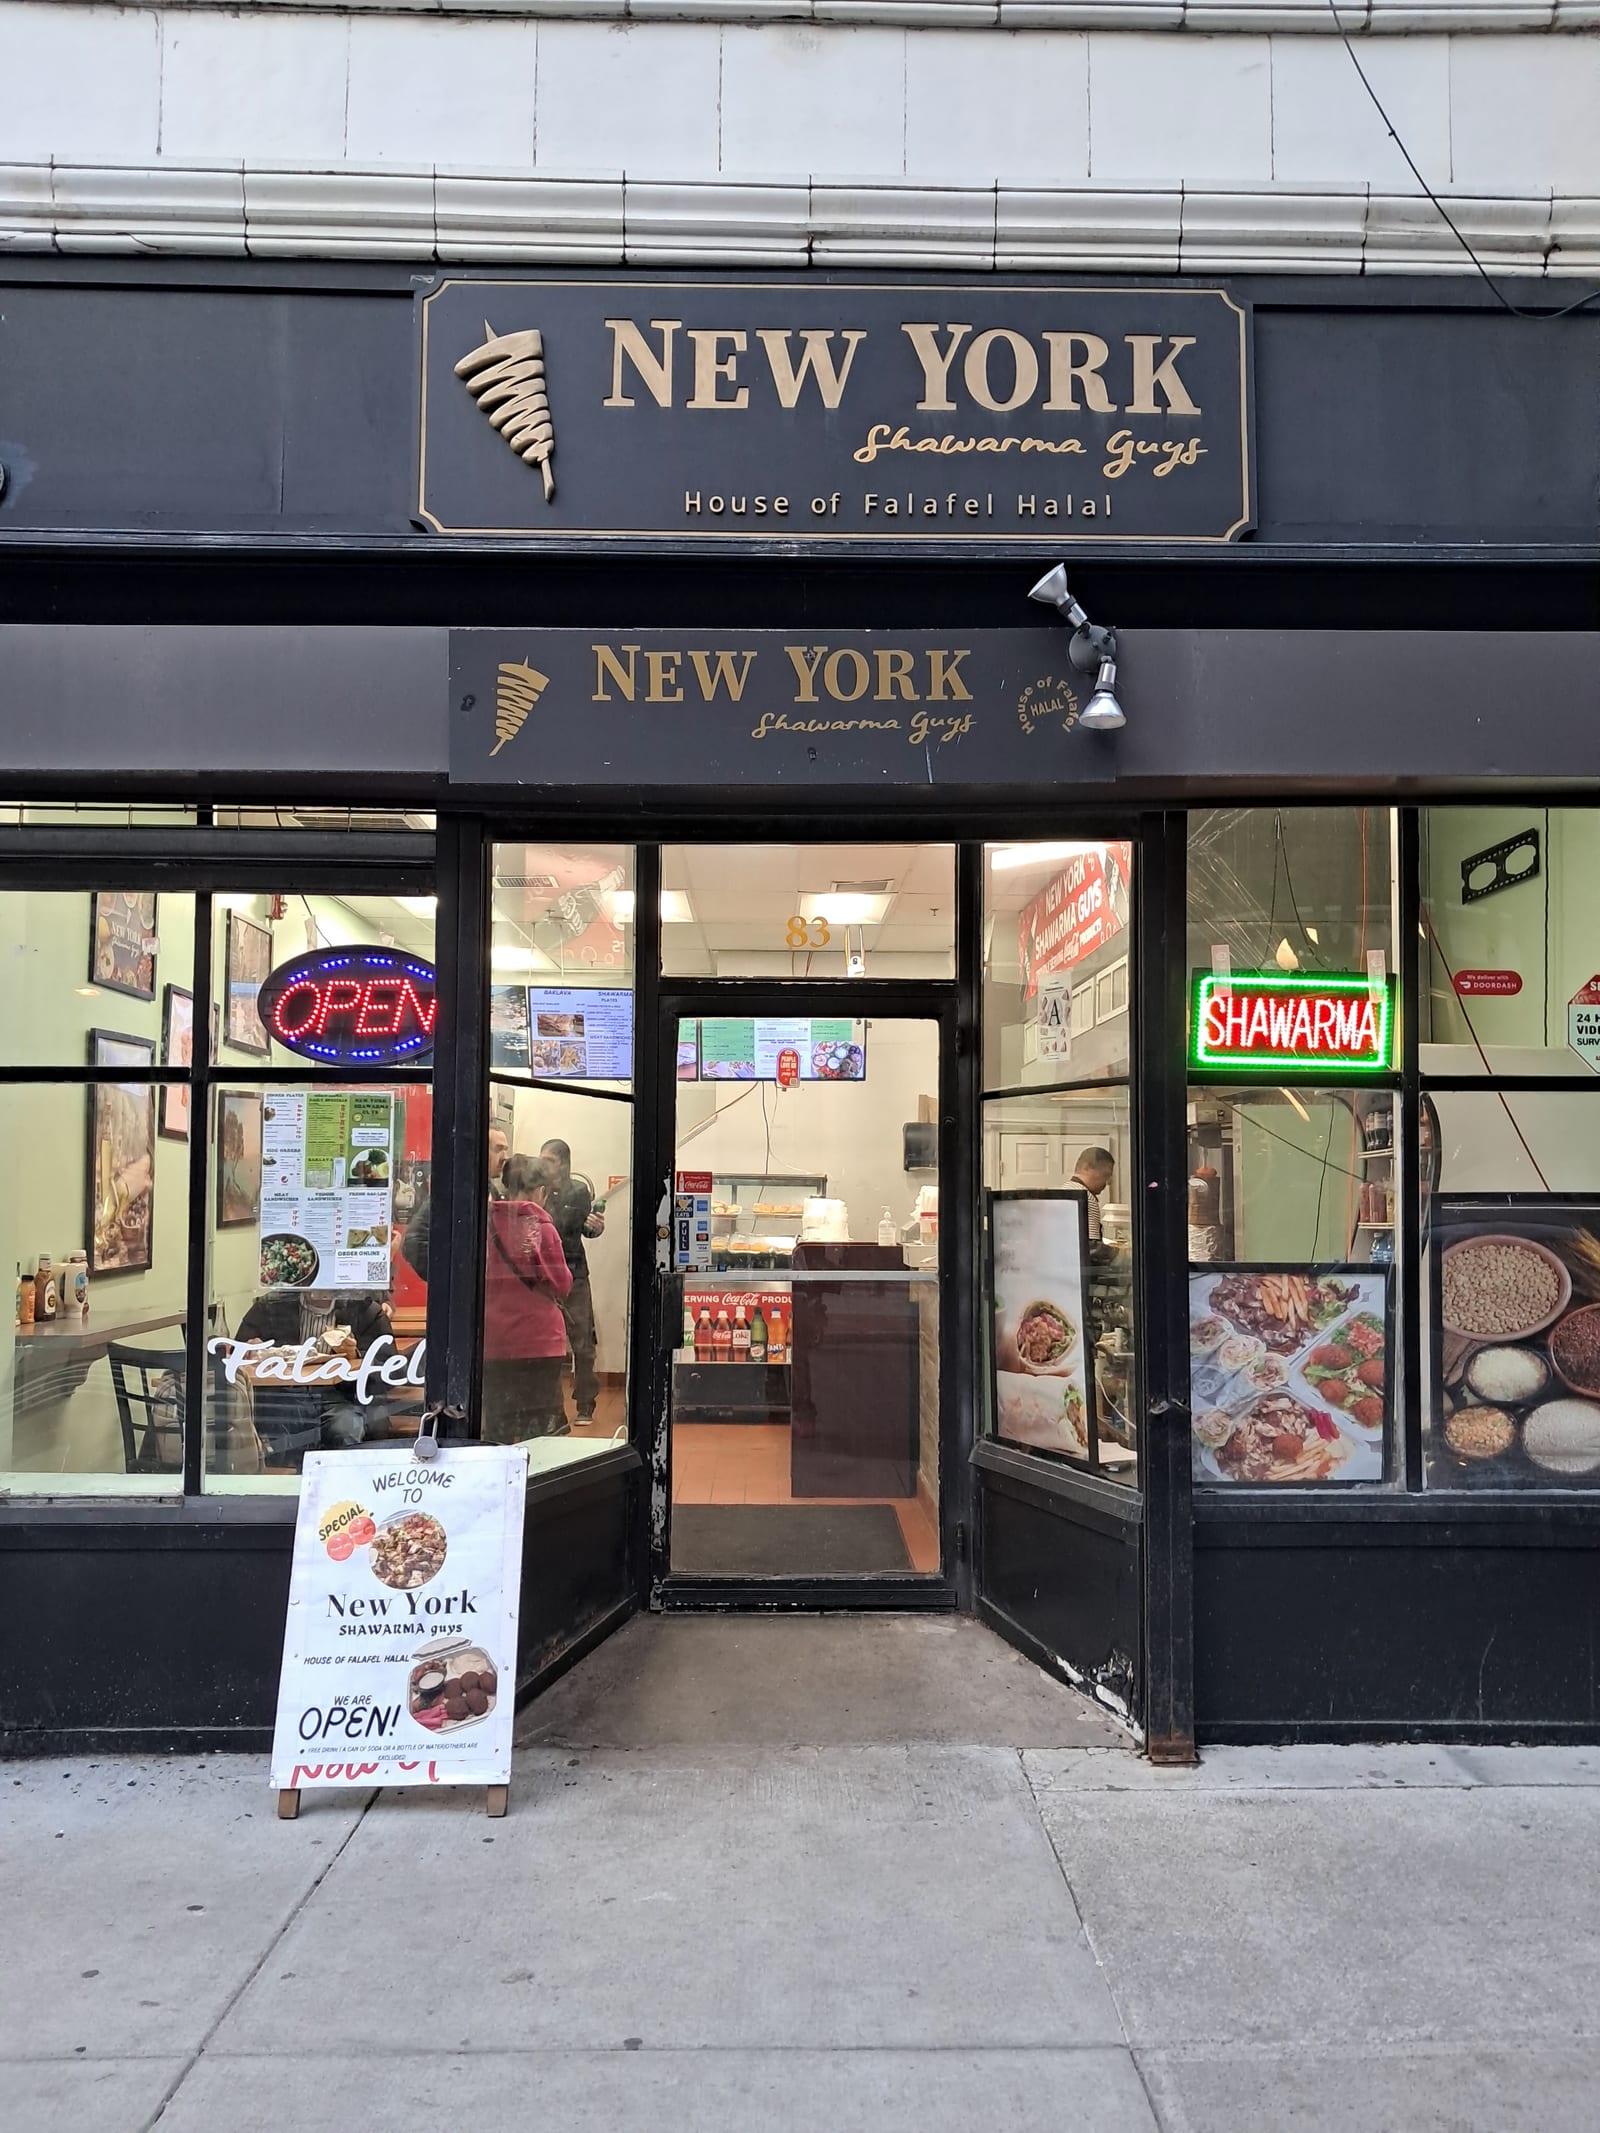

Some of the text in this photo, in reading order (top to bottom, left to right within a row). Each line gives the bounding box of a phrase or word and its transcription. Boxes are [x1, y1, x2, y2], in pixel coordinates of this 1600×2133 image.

[602, 318, 1202, 415] NEW YORK
[853, 424, 1209, 480] Shawarma Guys
[684, 491, 1111, 517] House of Falafel Halal
[590, 644, 974, 702] NEW YORK
[1017, 675, 1080, 735] House of Falafel
[1030, 698, 1065, 717] HALAL
[751, 710, 977, 745] Shawarma Guys
[1045, 854, 1086, 916] NEW YORK
[785, 915, 831, 948] 83
[1034, 902, 1078, 961] SHAWARMA
[1077, 877, 1103, 923] GUYS
[273, 977, 438, 1036] OPEN
[1048, 999, 1061, 1026] A
[1204, 995, 1379, 1051] SHAWARMA
[1577, 1013, 1591, 1023] 24
[372, 1469, 456, 1493] WELCOME
[402, 1487, 423, 1504] TO
[318, 1503, 365, 1542] SPECIAL
[325, 1589, 479, 1618] New York
[338, 1622, 464, 1637] SHAWARMA guys
[303, 1654, 410, 1665] HOUSE OF FALAFEL HALAL
[334, 1694, 373, 1706] WE ARE
[298, 1703, 402, 1741] OPEN!
